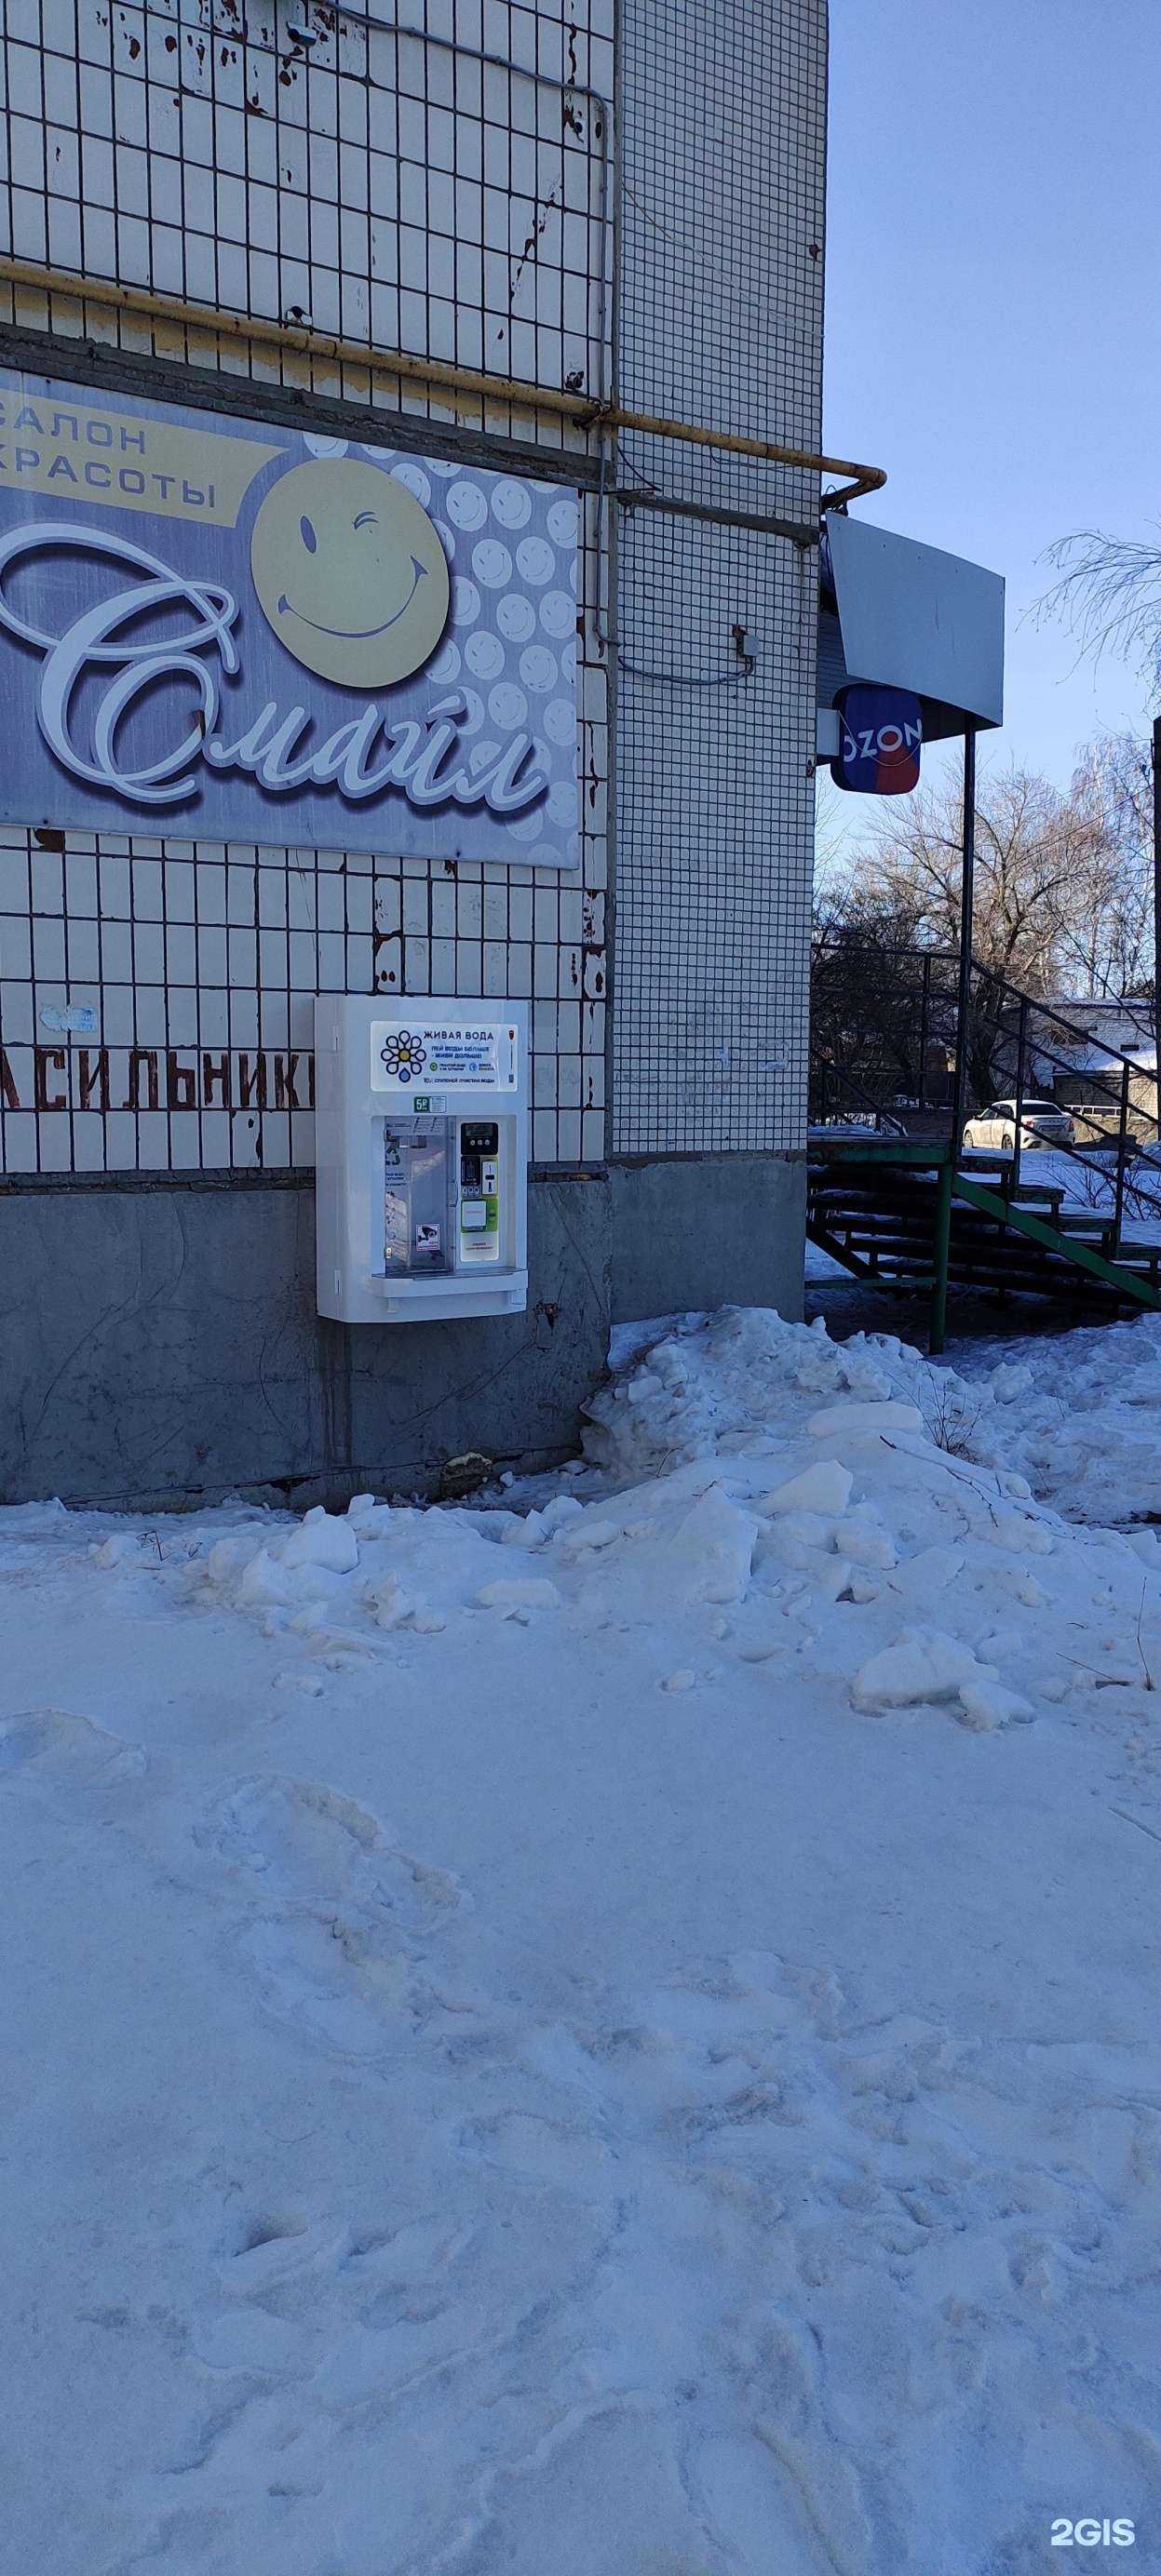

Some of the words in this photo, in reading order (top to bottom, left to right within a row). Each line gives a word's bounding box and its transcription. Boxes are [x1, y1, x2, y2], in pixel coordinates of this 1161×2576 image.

[0, 522, 548, 812] Смайл
[424, 1030, 462, 1040] ЖИВАЯ
[465, 1031, 494, 1040] ВОДА
[0, 1047, 314, 1110] АСИЛЬНИК
